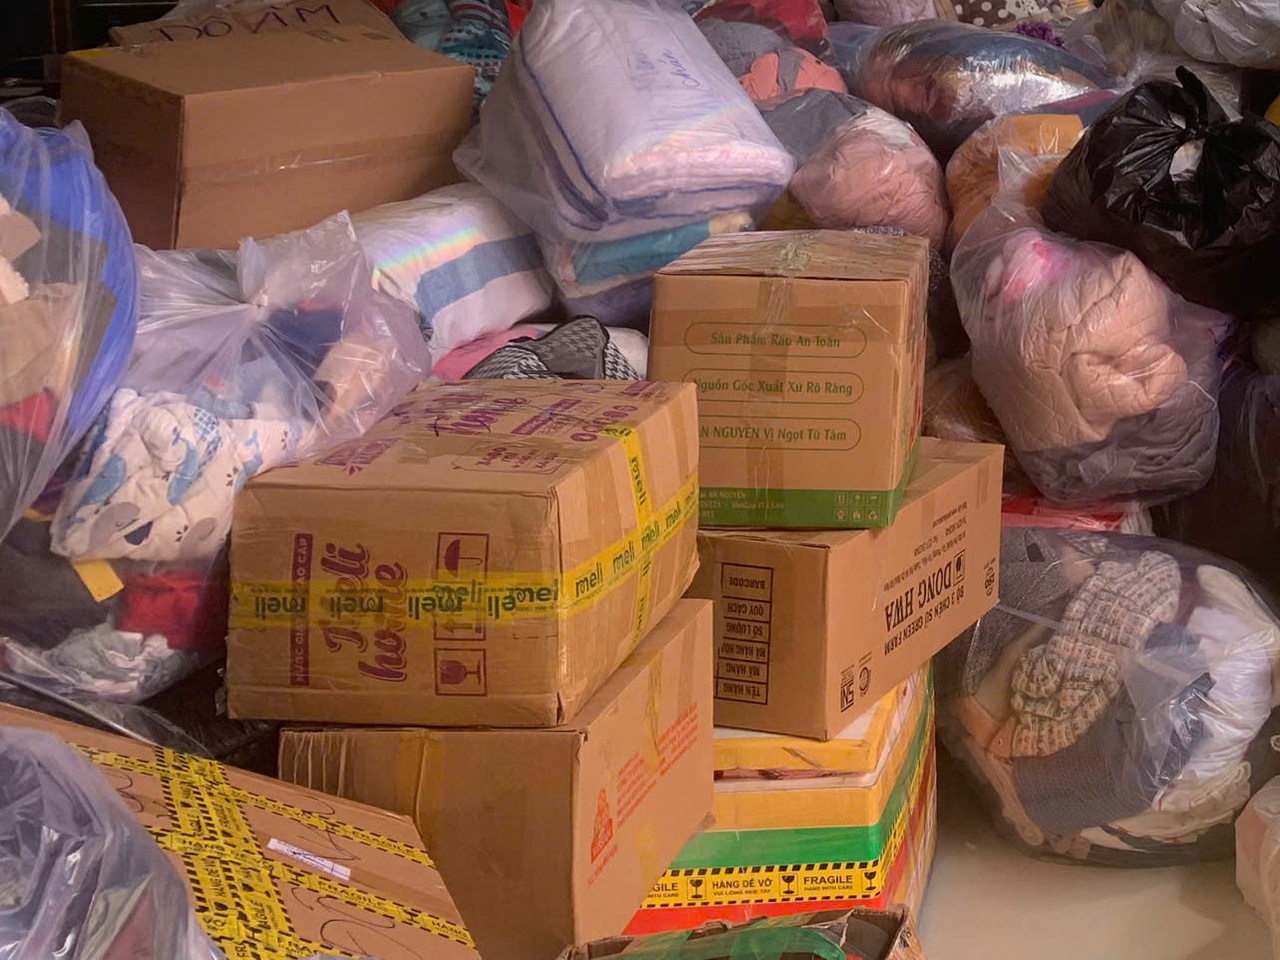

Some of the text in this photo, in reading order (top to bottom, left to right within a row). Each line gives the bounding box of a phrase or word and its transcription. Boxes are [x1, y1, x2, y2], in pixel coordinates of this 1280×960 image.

[575, 563, 603, 597] meli
[613, 540, 634, 573] meli
[729, 577, 765, 589] BARCODE
[885, 561, 952, 632] DONG HWA
[329, 595, 384, 619] meli
[749, 606, 764, 616] QUY
[804, 875, 853, 884] FRAGILE
